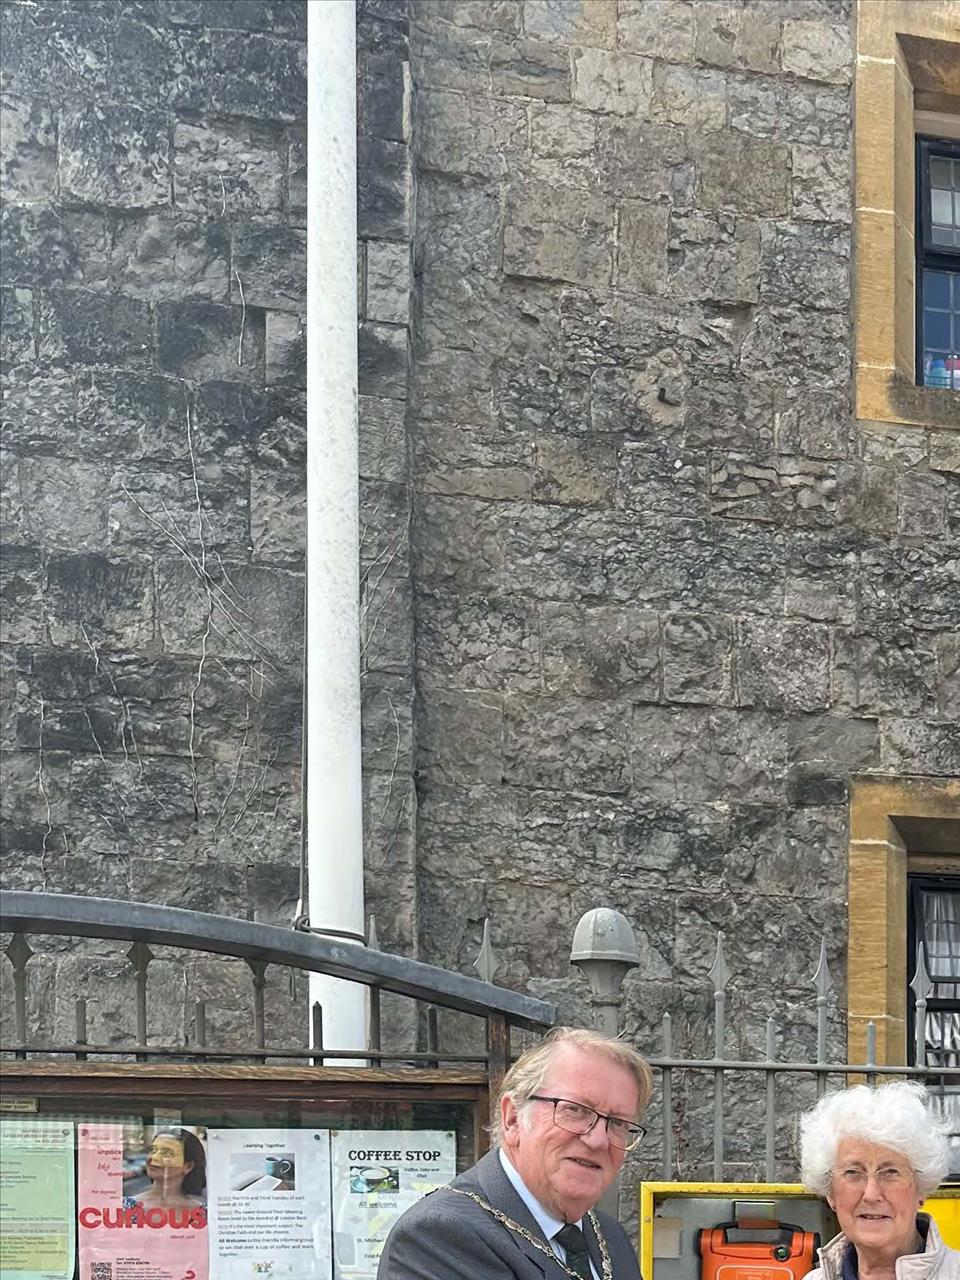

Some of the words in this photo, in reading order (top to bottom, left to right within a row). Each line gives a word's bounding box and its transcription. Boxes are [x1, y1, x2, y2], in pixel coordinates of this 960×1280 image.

[244, 1142, 264, 1150] Learning
[264, 1142, 286, 1150] Together
[348, 1150, 402, 1161] COFFEE
[405, 1150, 441, 1161] STOP
[368, 1200, 398, 1208] welcome
[79, 1203, 208, 1229] curious
